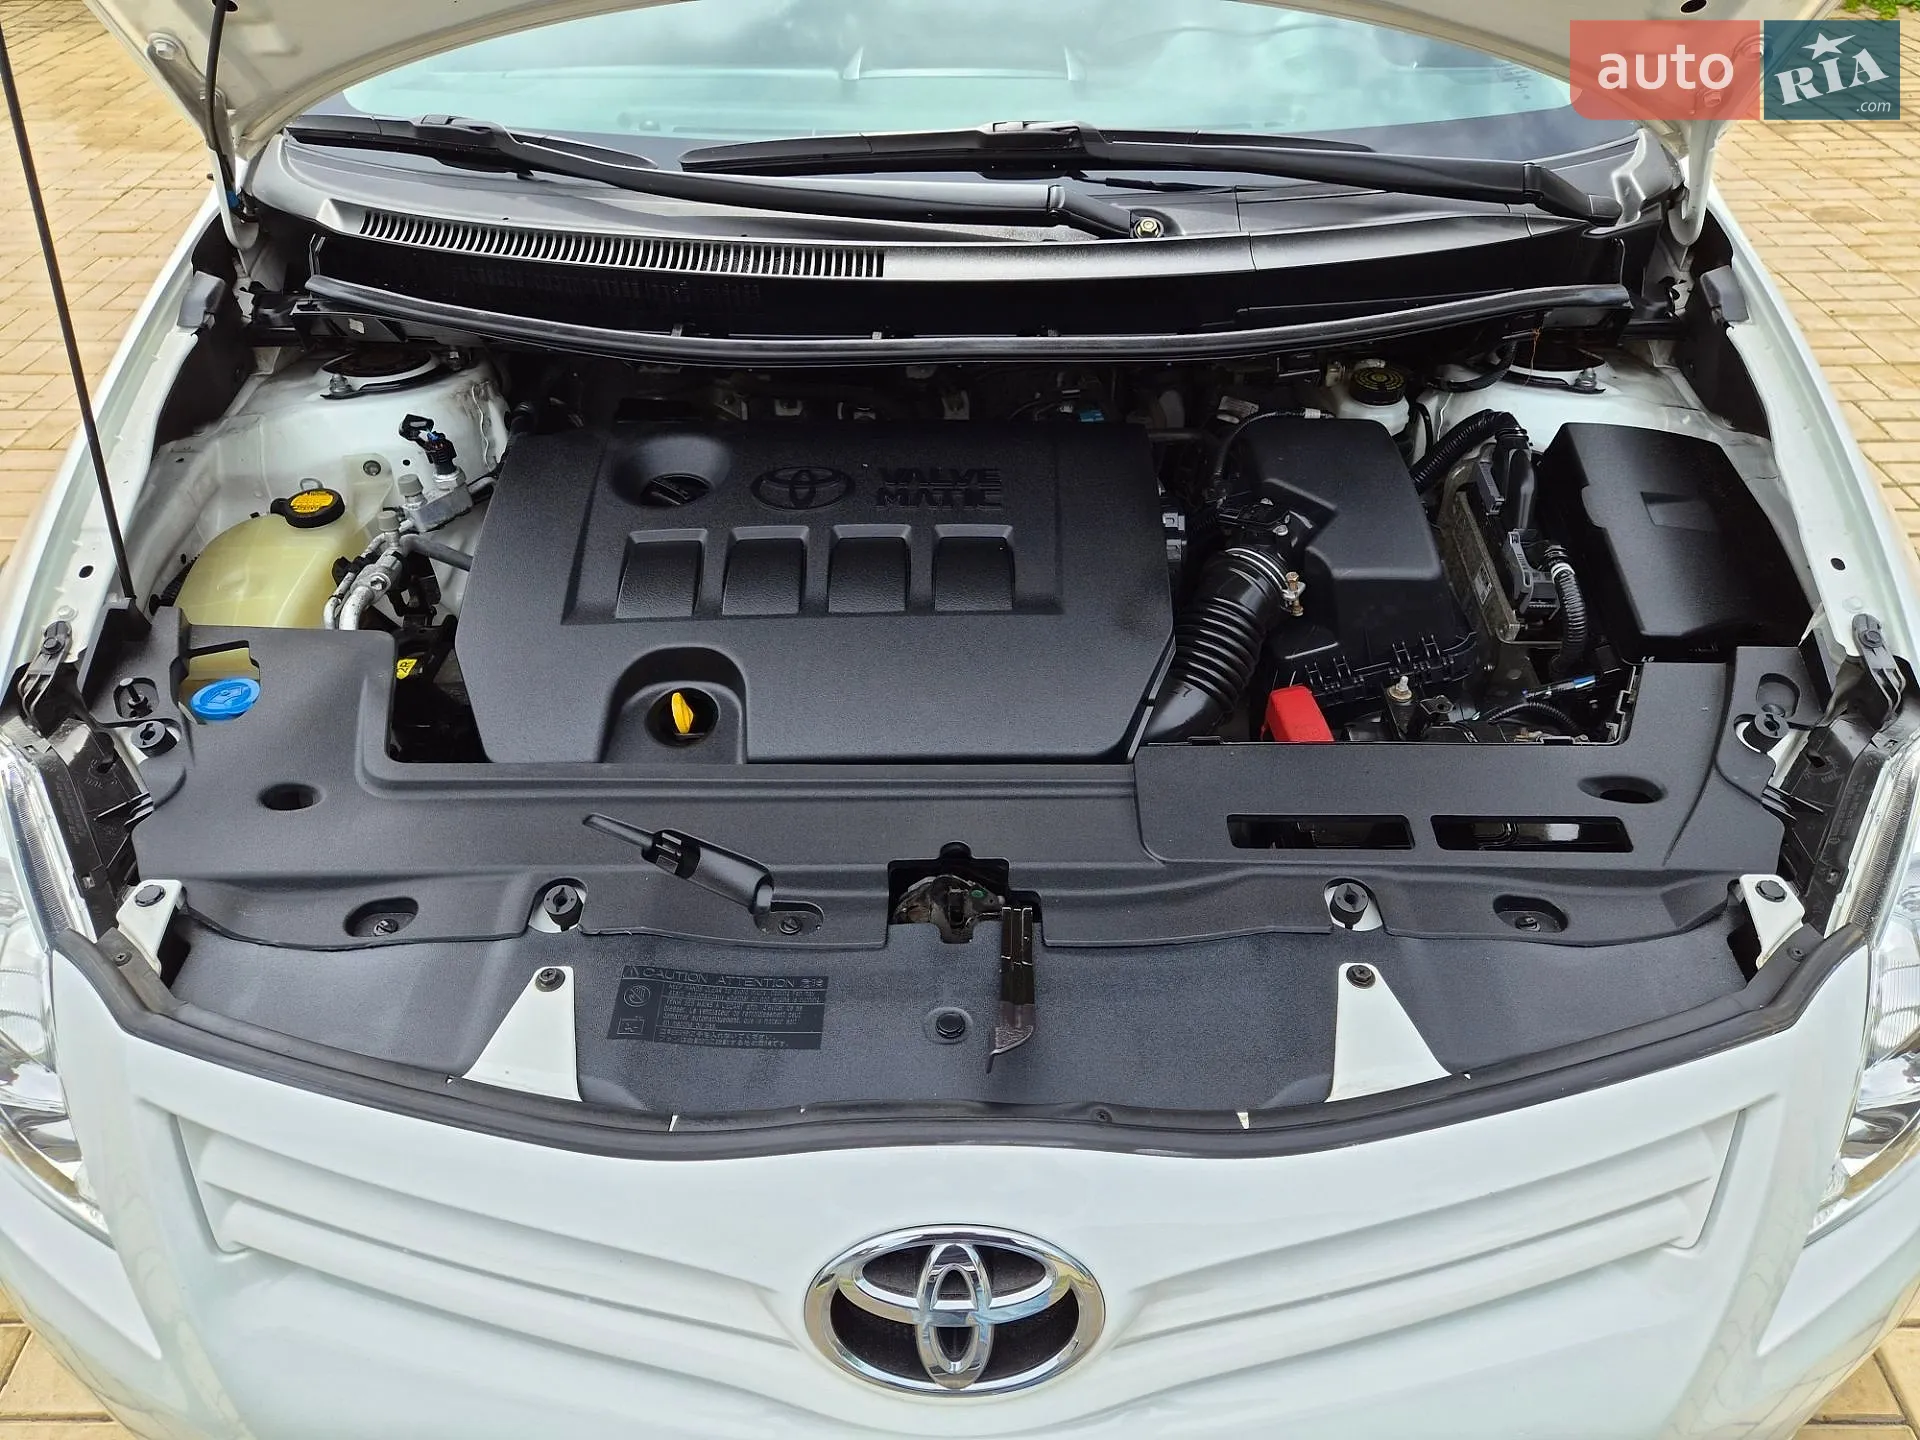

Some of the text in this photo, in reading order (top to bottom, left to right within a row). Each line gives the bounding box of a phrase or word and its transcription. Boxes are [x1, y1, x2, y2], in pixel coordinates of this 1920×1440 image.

[879, 468, 1001, 488] VALVE
[872, 488, 1002, 511] MATIC
[642, 968, 707, 984] CAUTION
[718, 975, 795, 988] ATTENTION
